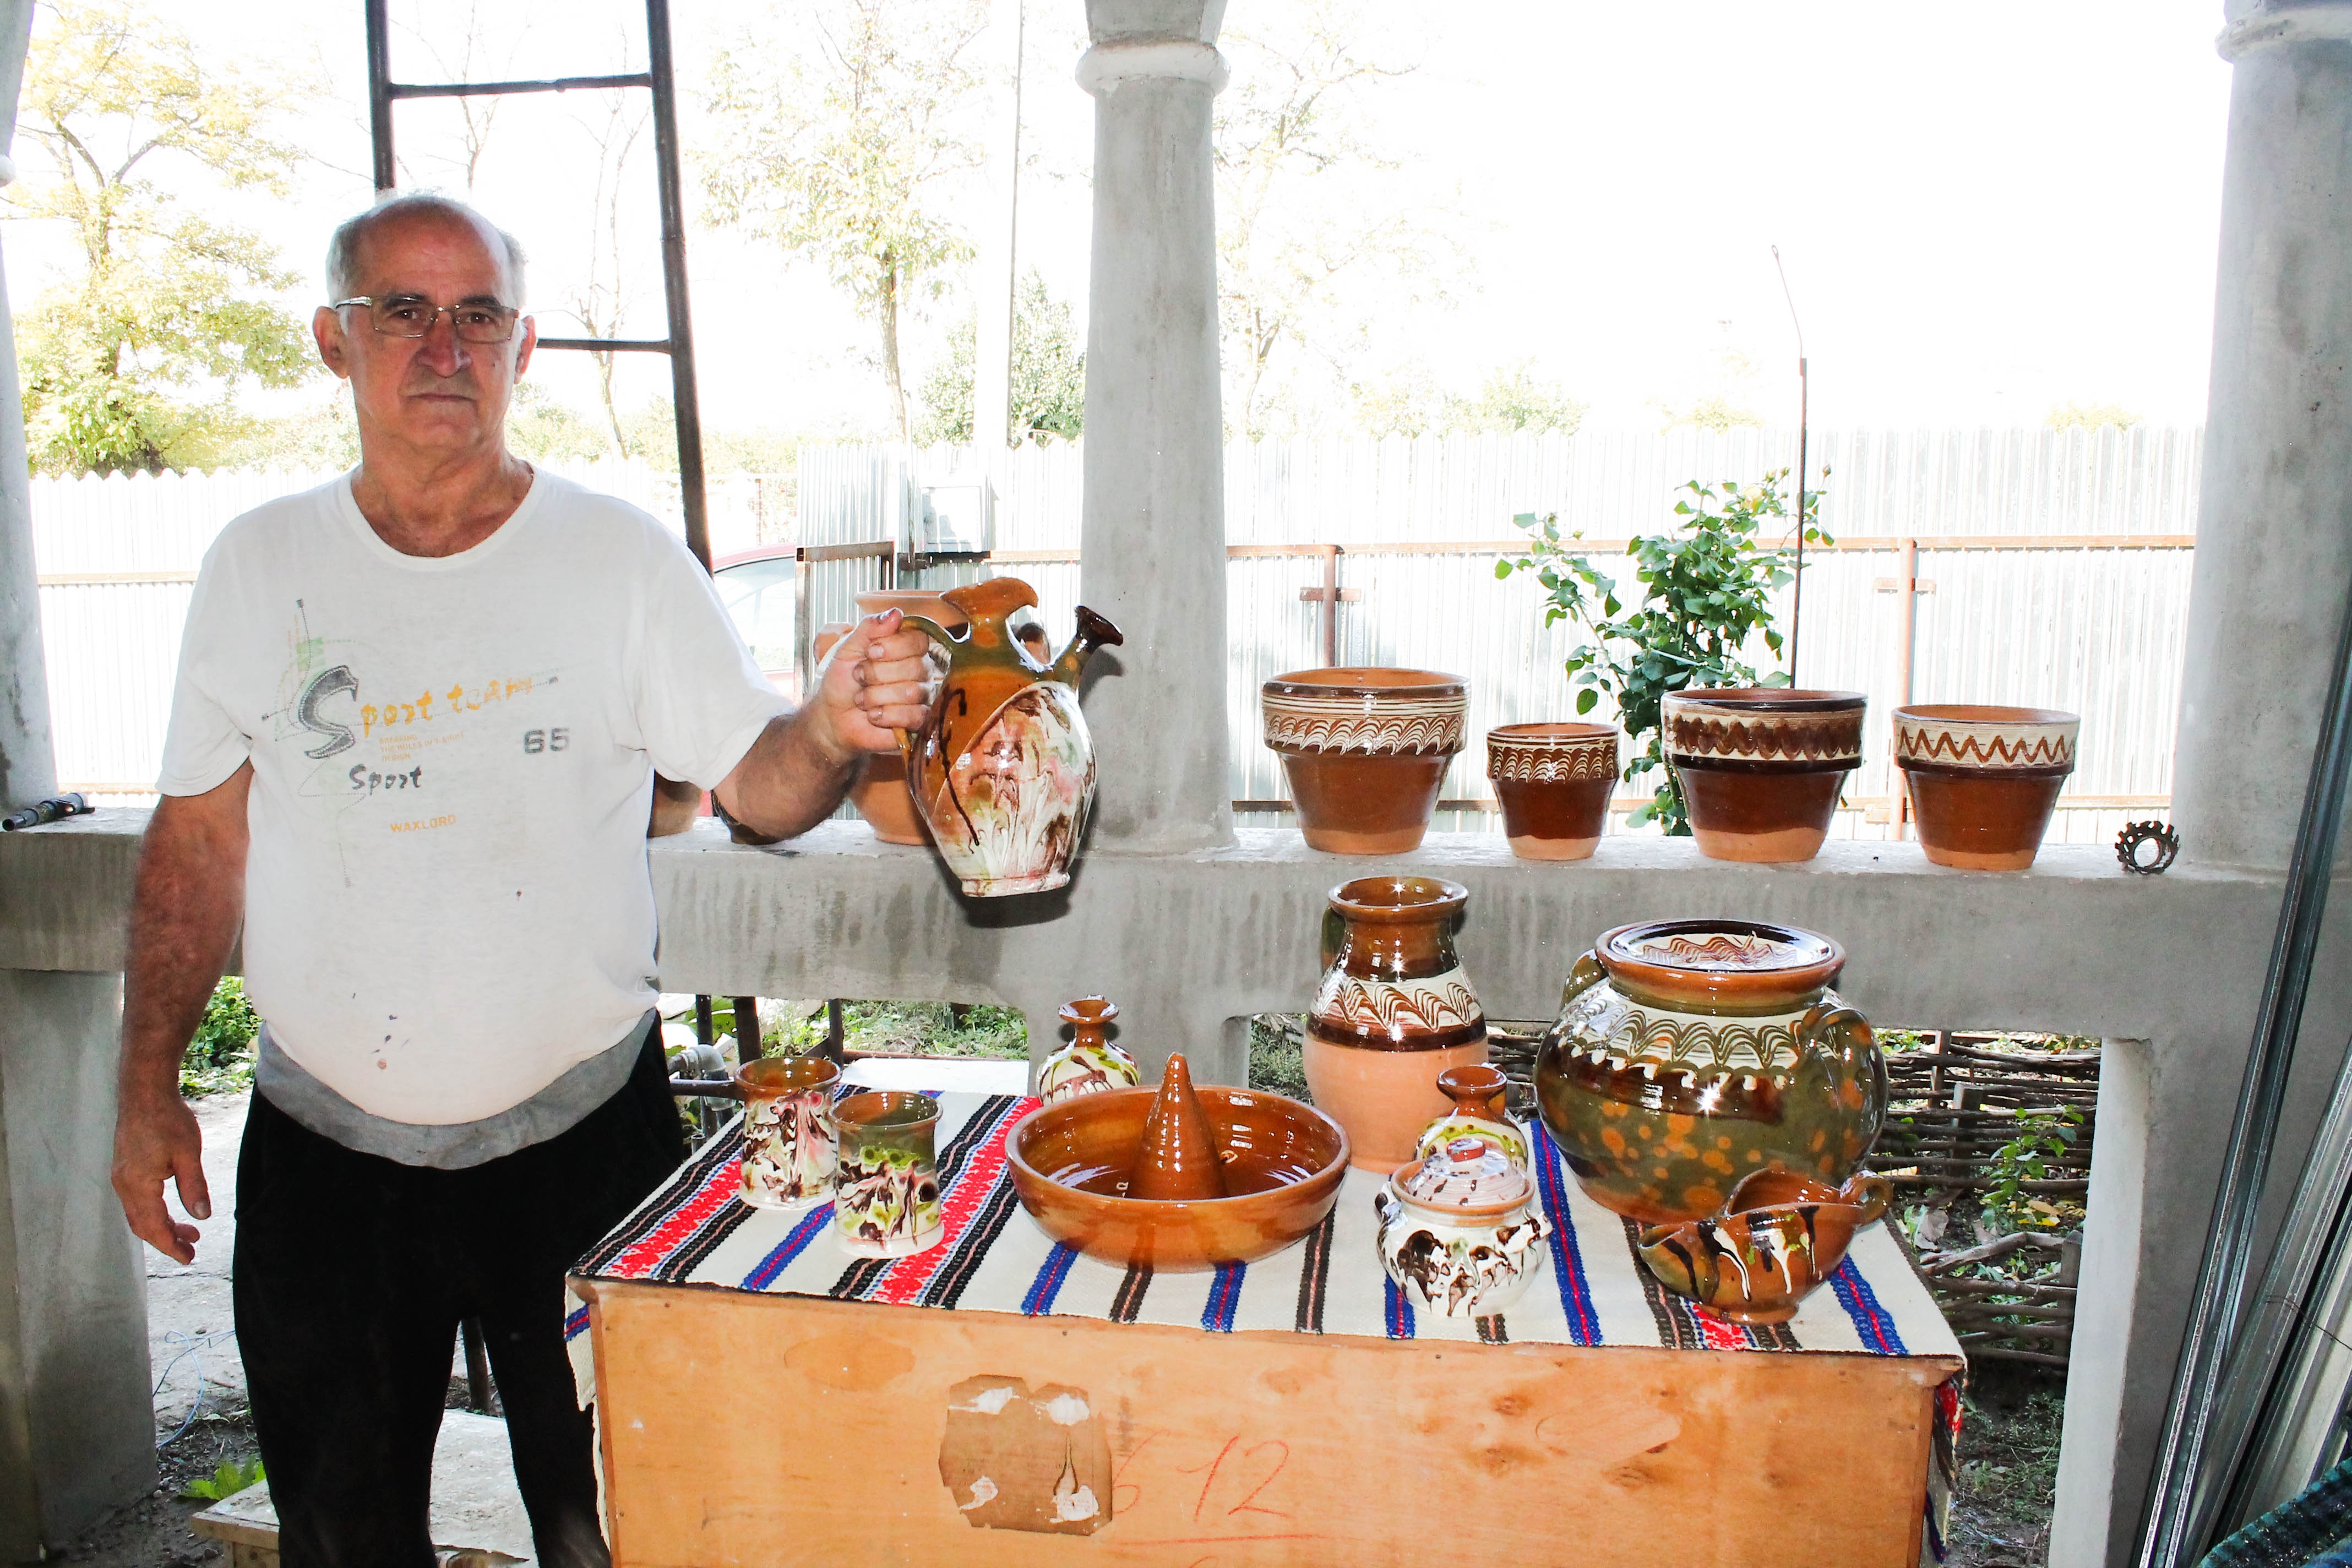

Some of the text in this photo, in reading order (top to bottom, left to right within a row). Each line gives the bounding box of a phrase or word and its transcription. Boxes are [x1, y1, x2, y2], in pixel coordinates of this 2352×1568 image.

[524, 727, 569, 754] 65
[349, 764, 422, 796] Sport
[390, 814, 456, 832] WAXLORD
